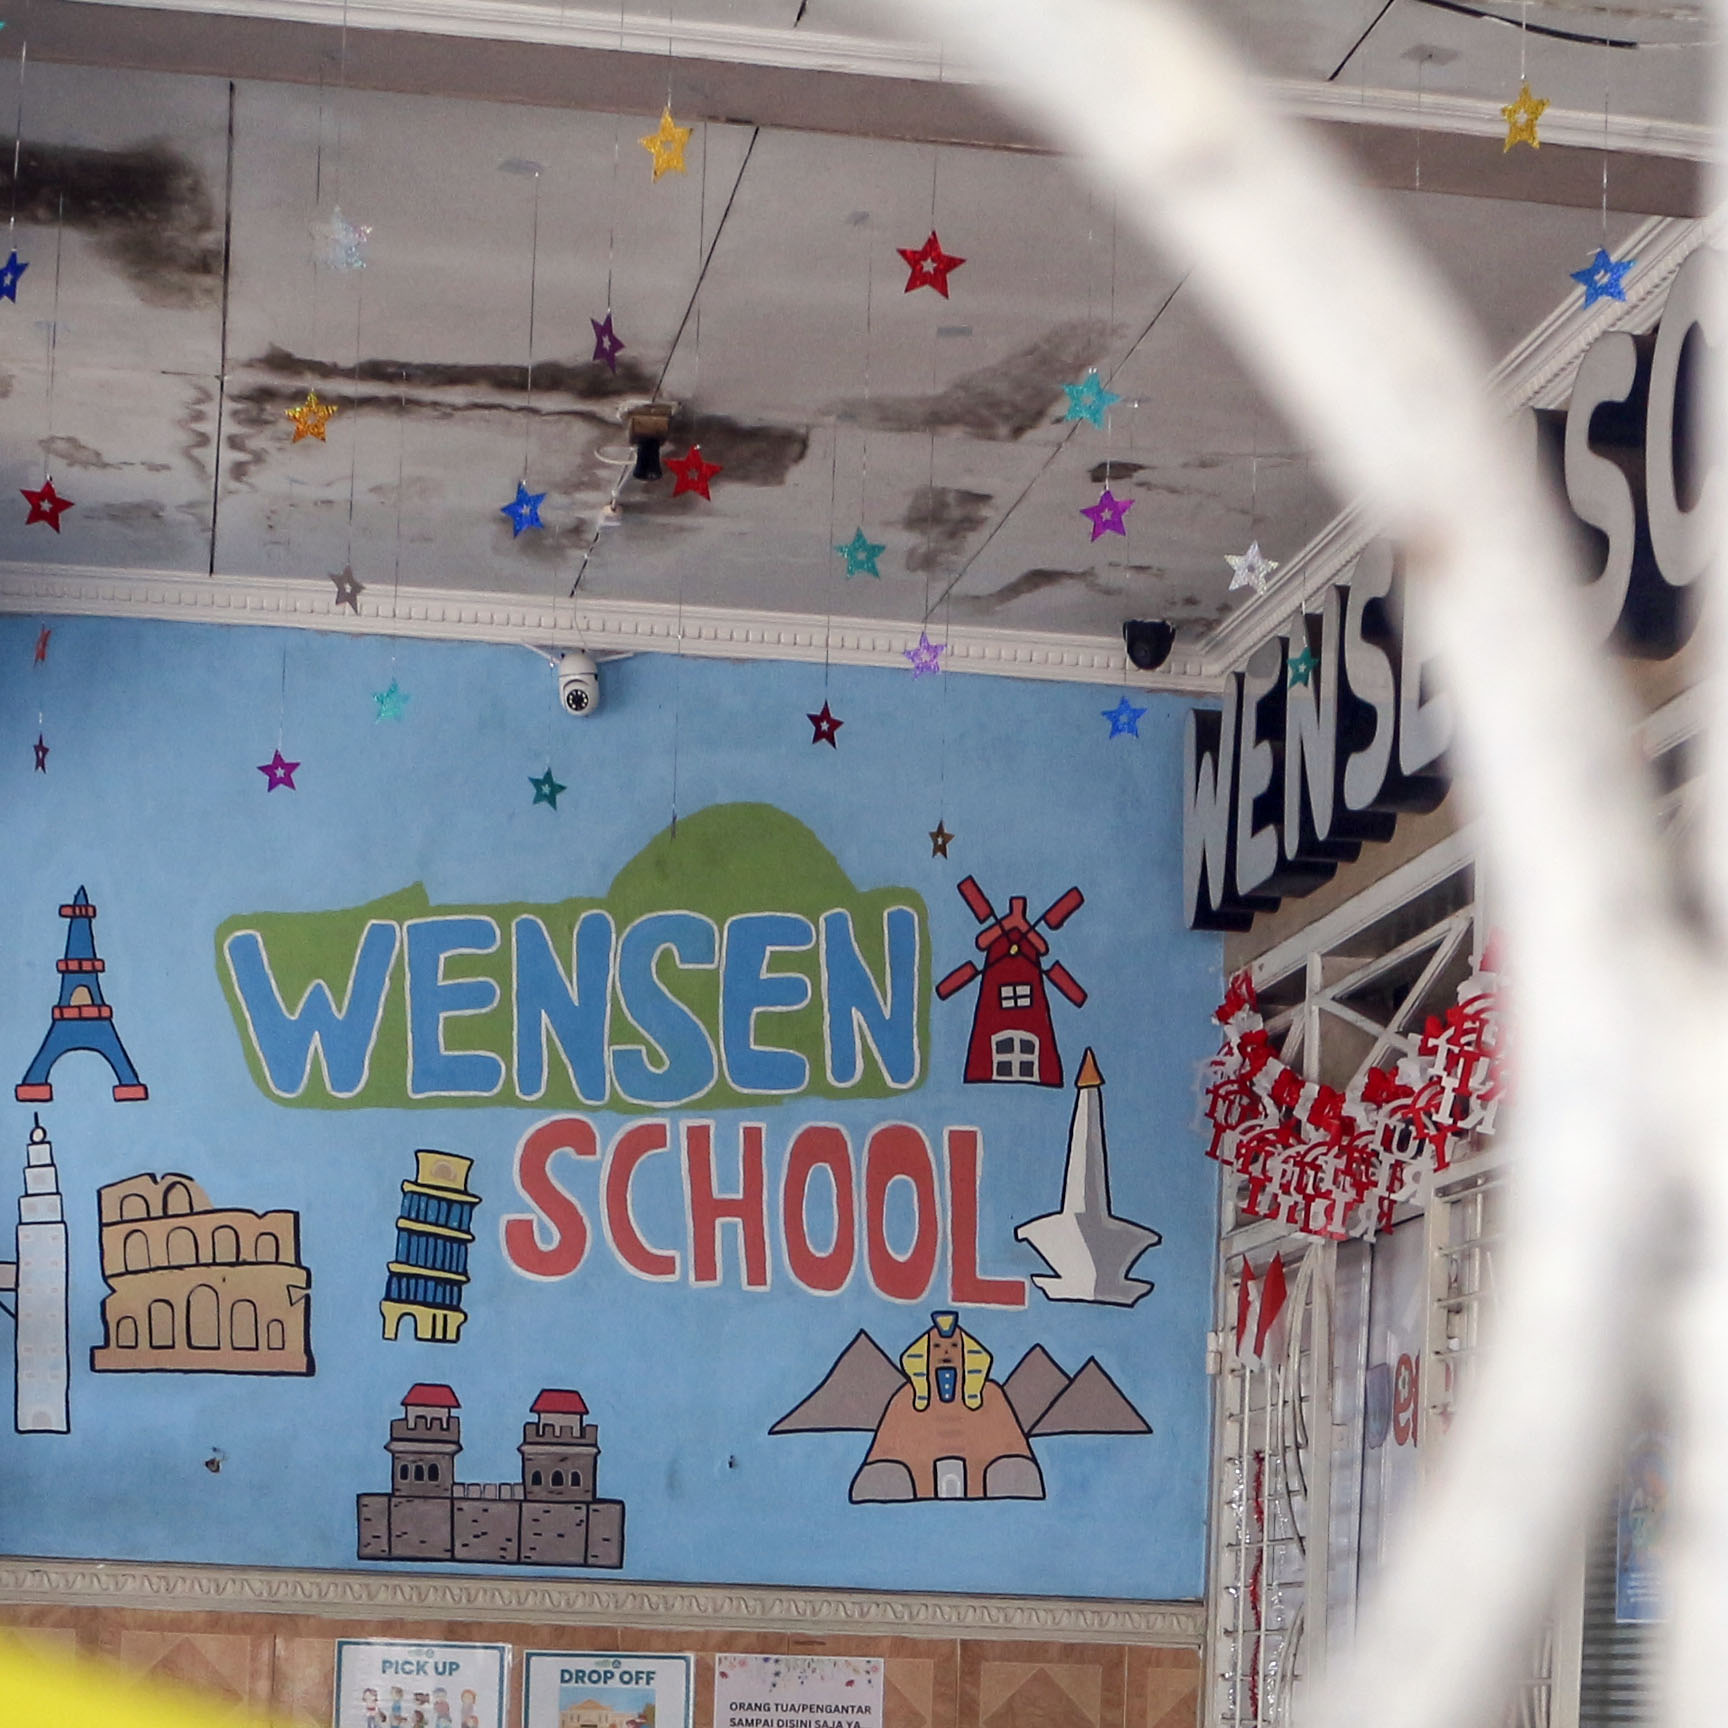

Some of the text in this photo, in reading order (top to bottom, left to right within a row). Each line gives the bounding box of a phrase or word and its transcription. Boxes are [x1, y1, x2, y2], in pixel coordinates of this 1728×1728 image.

[225, 906, 920, 1106] WENSEN
[500, 1115, 1027, 1307] SCHOOL
[381, 1659, 460, 1677] PICK UP
[560, 1669, 656, 1686] DROP OFF
[729, 1702, 872, 1714] ORANG TUA/PENGANTAR
[729, 1717, 773, 1728] SAMPAI
[776, 1718, 812, 1728] DISINI
